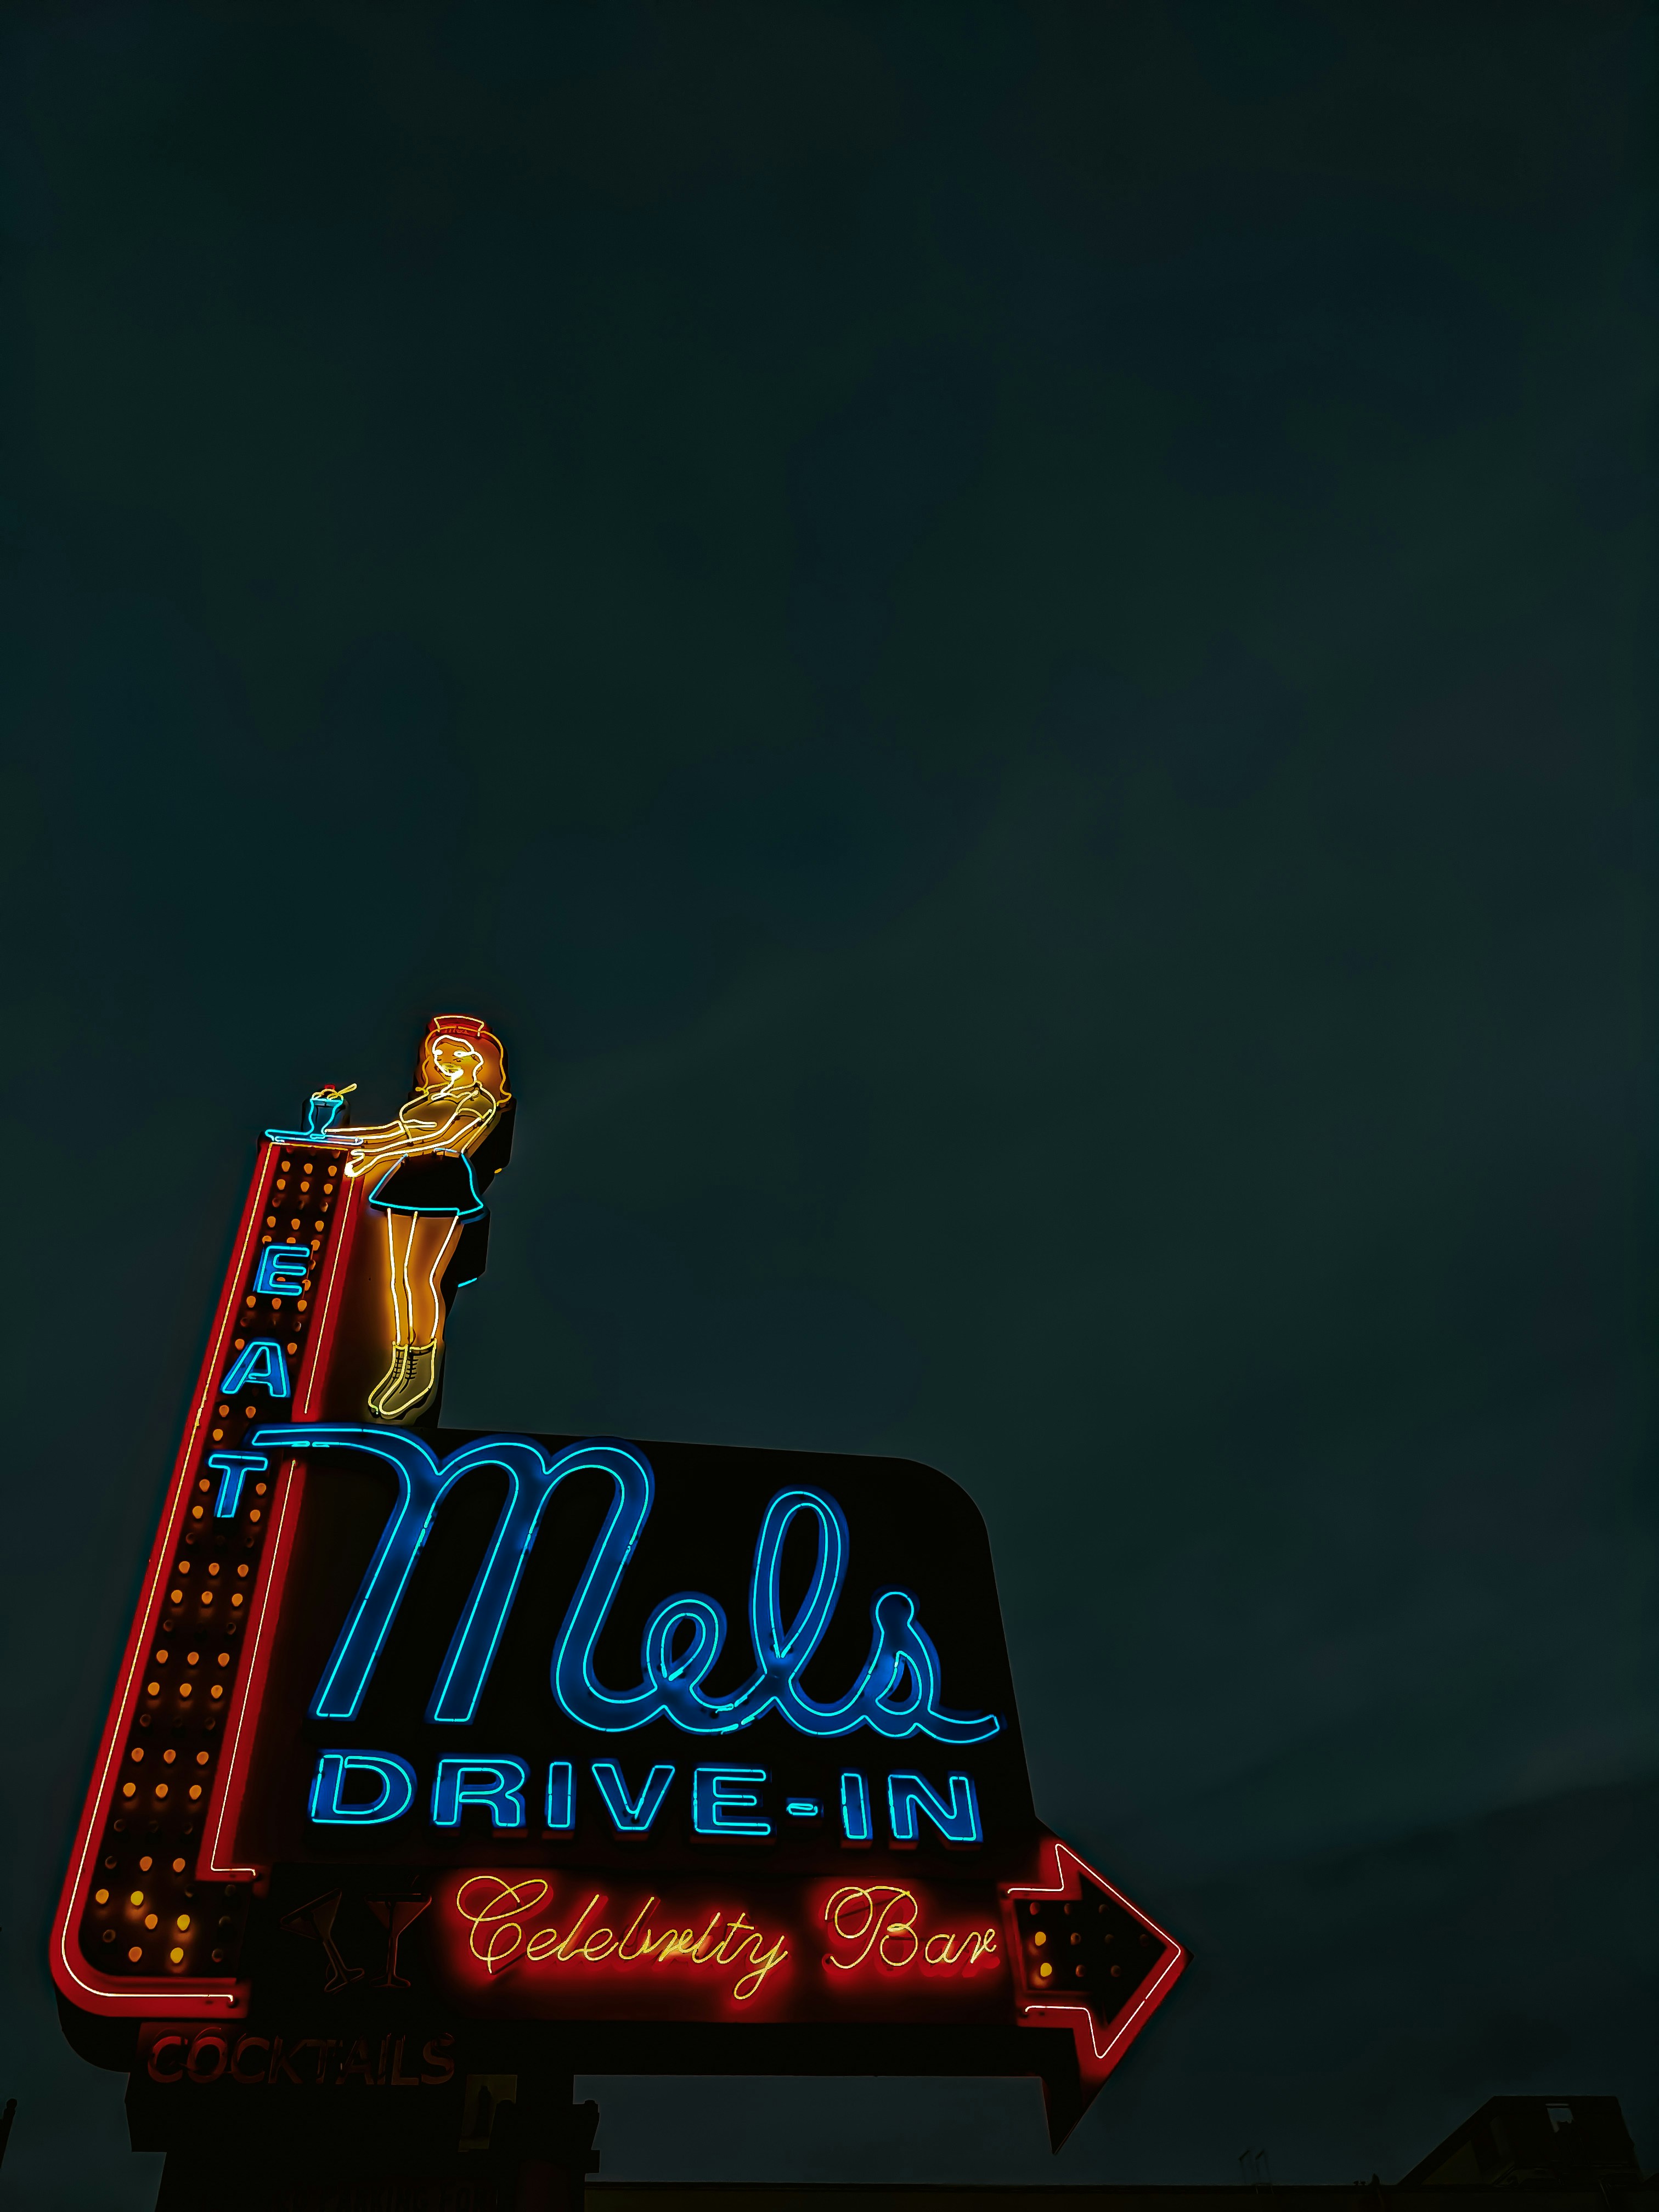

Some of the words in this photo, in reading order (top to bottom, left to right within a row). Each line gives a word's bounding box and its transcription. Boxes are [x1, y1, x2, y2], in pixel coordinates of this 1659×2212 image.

[206, 1244, 311, 1518] EAT
[242, 1423, 1005, 1744] Mels
[307, 1750, 984, 1842] DRIVE-IN
[456, 1875, 788, 2000] Celebrity
[824, 1885, 997, 1970] Bar
[147, 2028, 456, 2085] COCKTAILS
